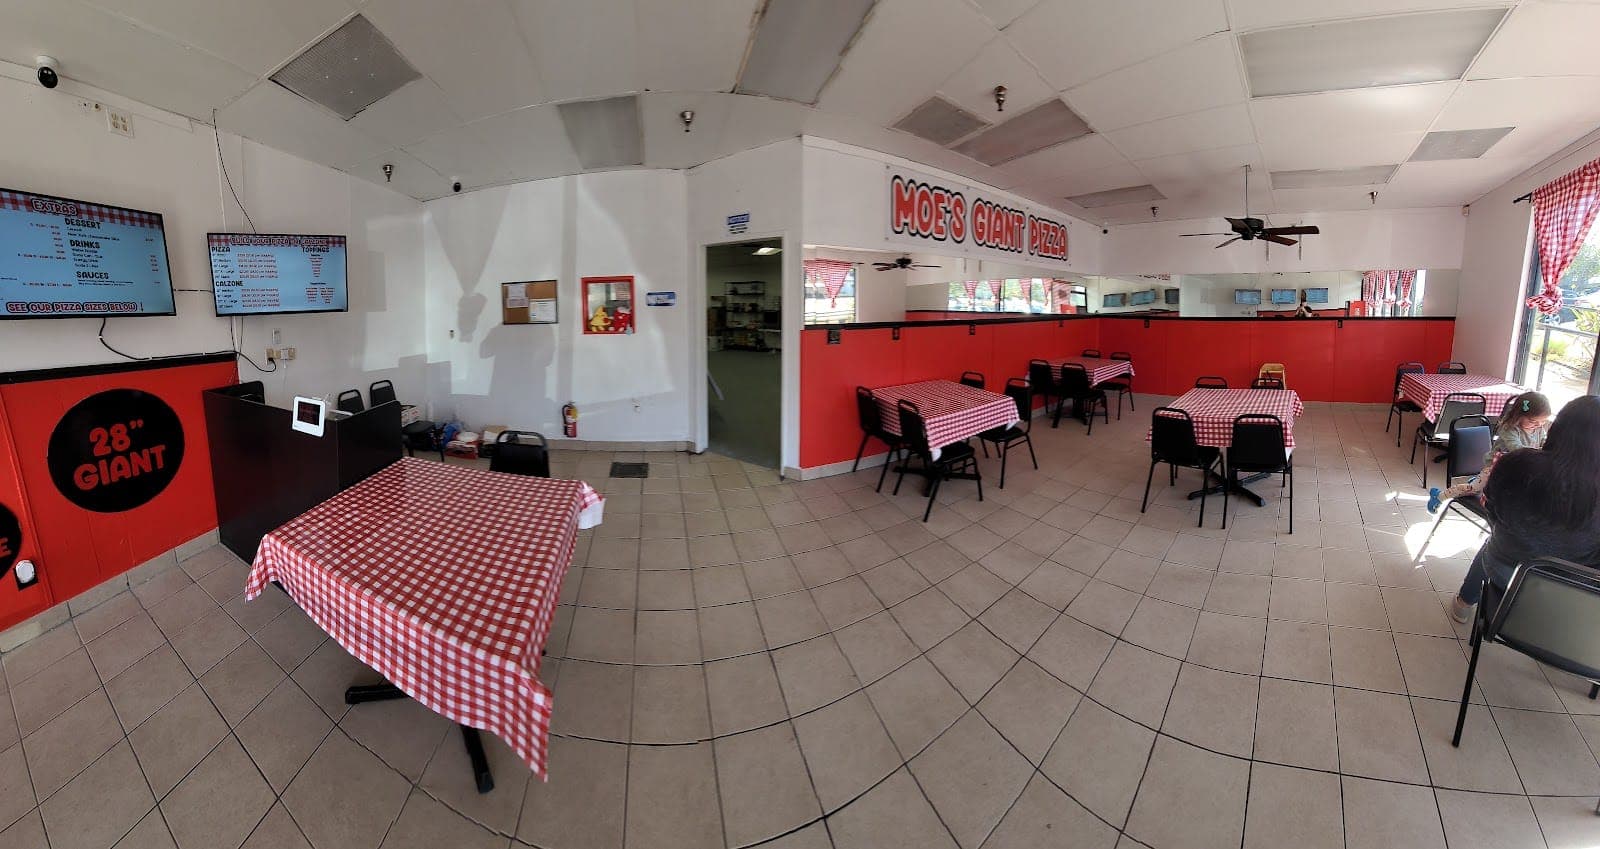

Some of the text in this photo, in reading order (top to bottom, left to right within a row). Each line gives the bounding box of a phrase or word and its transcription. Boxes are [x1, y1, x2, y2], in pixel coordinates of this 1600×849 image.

[33, 200, 77, 216] EXTRAS
[892, 175, 1069, 260] MOE'S GIANT PIZZA
[65, 218, 101, 229] DESSERT
[70, 239, 101, 249] DRINKS
[76, 271, 109, 280] SAUCES
[7, 302, 137, 313] SEE OUR PIZZA SIZES BELOW
[73, 444, 166, 491] GIANT
